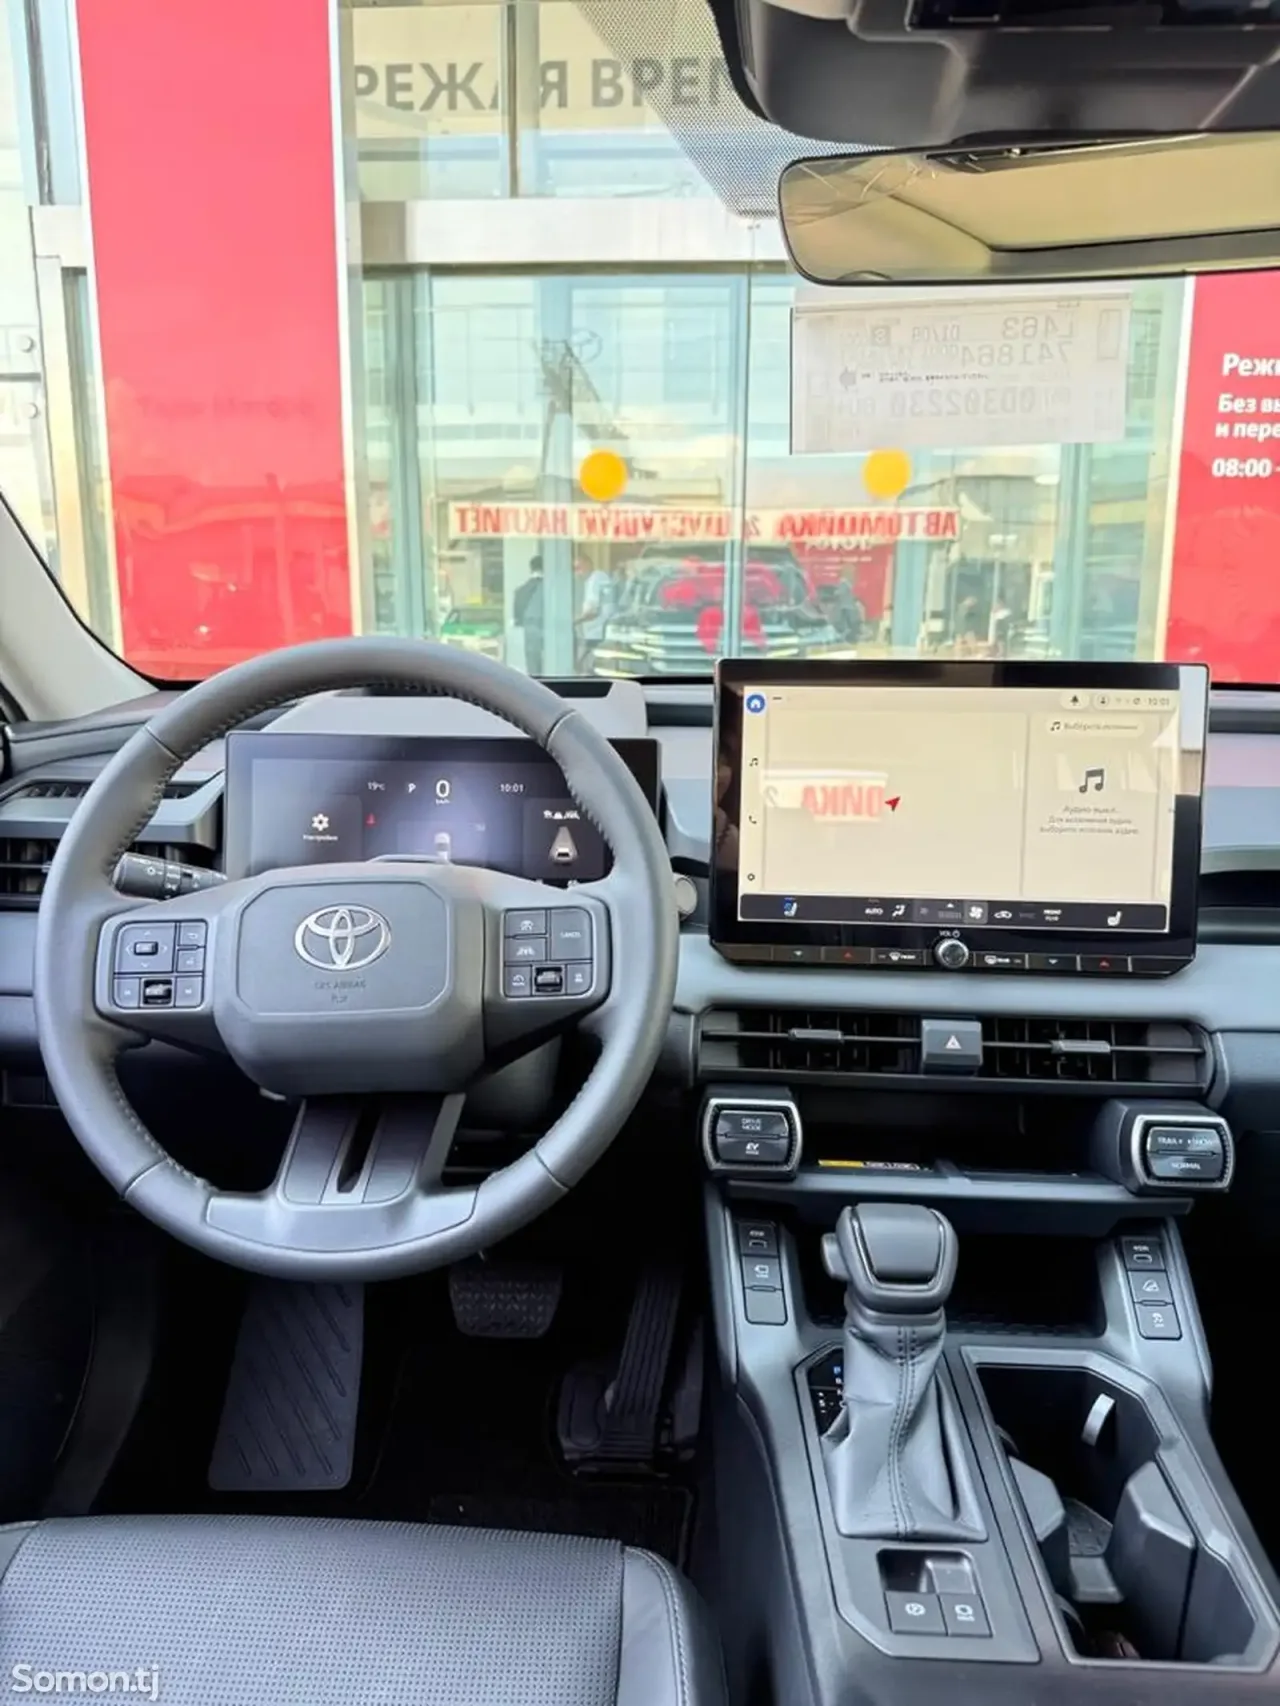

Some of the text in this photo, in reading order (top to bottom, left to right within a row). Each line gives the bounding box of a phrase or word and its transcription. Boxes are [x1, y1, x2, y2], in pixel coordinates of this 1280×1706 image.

[1218, 393, 1257, 413] Без
[1215, 423, 1229, 438] и
[1211, 457, 1272, 478] 08:00
[435, 778, 451, 798] 0
[500, 783, 524, 793] 10:01
